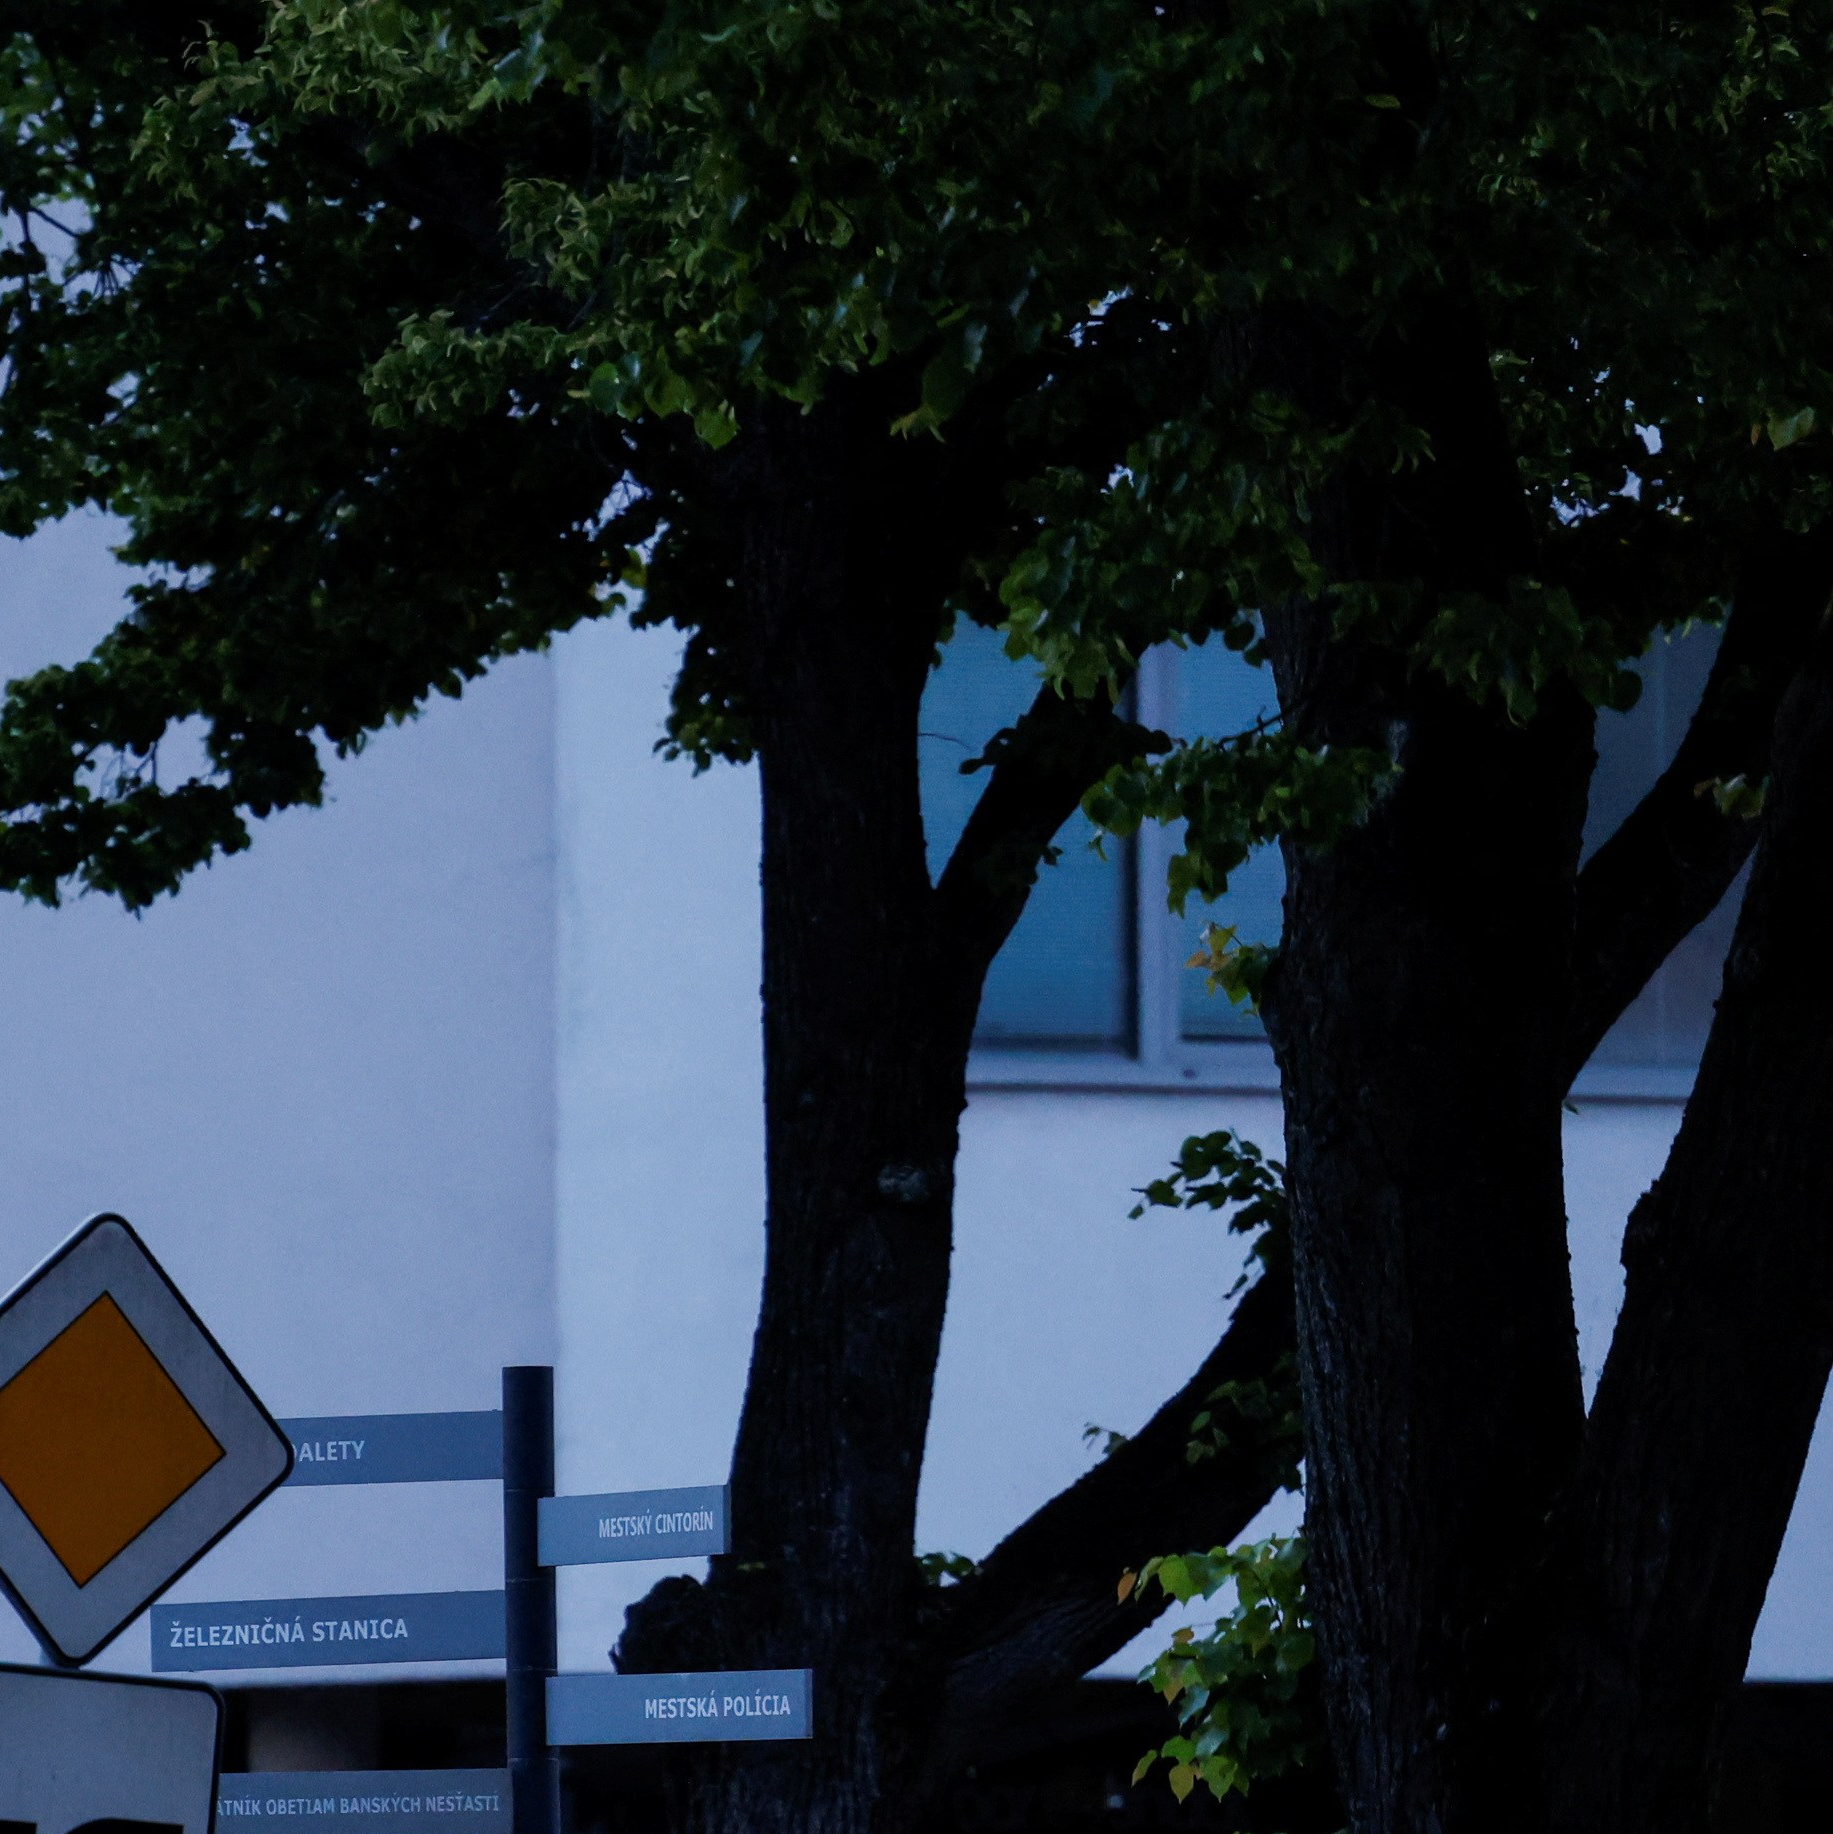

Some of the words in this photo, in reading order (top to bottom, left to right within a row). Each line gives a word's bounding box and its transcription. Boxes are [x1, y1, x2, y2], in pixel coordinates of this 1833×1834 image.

[598, 1508, 652, 1538] MESTSKÝ
[655, 1505, 713, 1534] CINTORÍN
[170, 1616, 305, 1648] ŽELEZNIČNÁ
[312, 1618, 409, 1643] STANICA
[645, 1689, 718, 1718] MESTSKÁ
[723, 1688, 791, 1717] POLÍCIA
[266, 1797, 335, 1816] OBETIAM
[340, 1791, 421, 1815] BANSKÝCH
[426, 1790, 499, 1812] NEŠŤASTÍ
